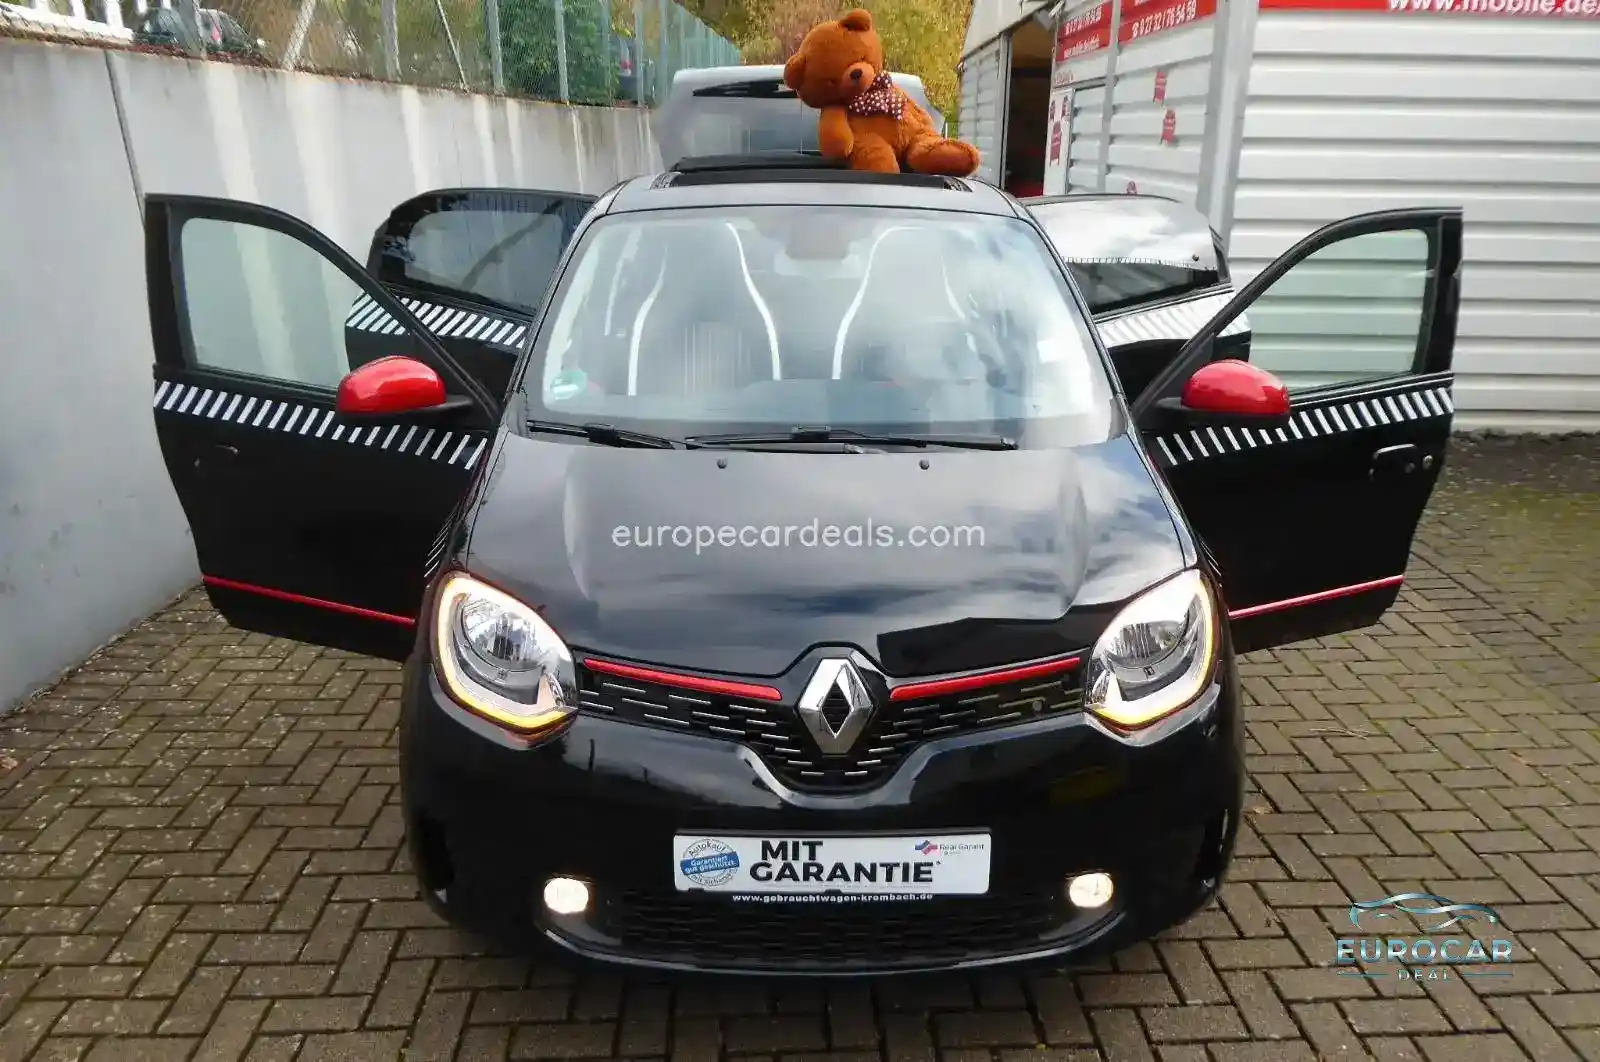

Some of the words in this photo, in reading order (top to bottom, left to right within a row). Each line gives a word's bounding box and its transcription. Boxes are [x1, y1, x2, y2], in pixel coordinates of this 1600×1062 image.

[1389, 0, 1600, 14] www.mobile.de
[760, 839, 824, 862] MIT
[749, 861, 934, 883] GARANTIE
[732, 893, 933, 904] www.gebrauchtwagen-krombach.de
